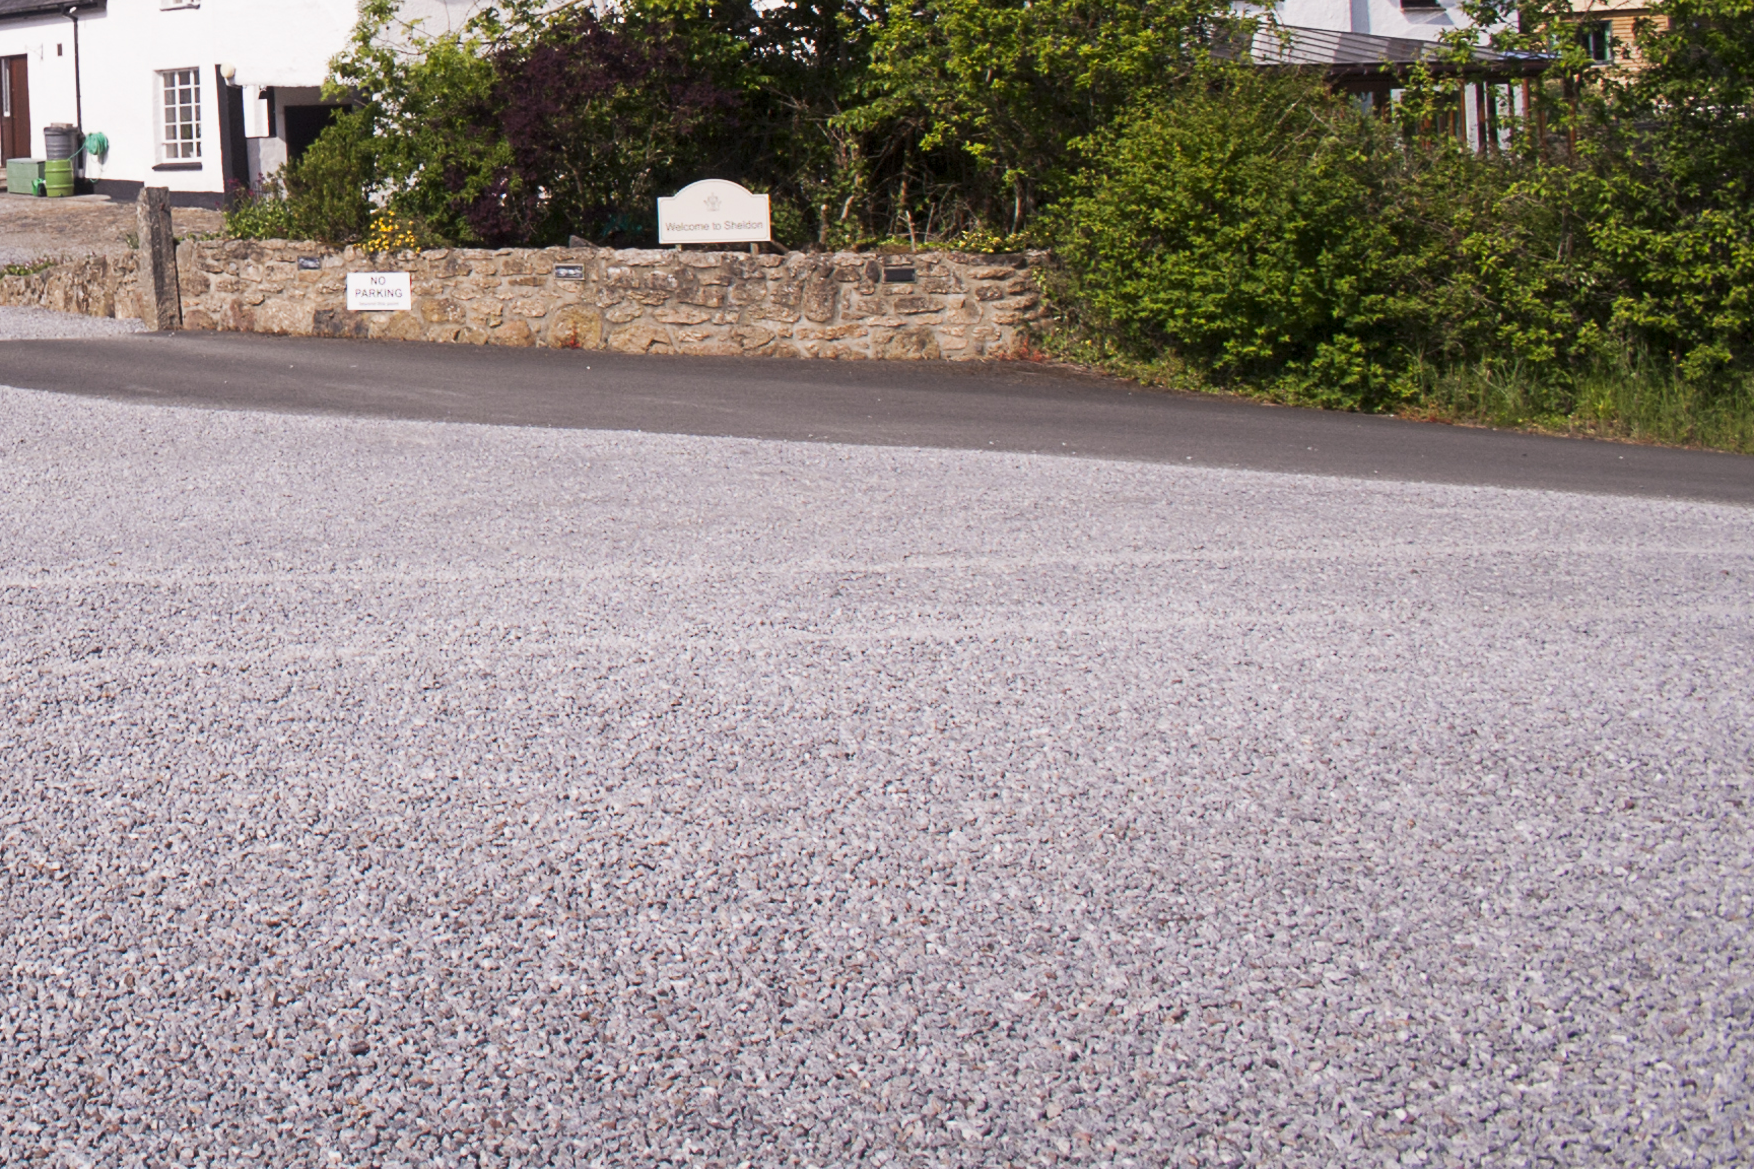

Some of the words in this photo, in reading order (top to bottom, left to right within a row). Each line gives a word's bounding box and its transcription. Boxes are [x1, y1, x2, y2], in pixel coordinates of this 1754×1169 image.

[665, 222, 710, 232] Welcome
[712, 221, 722, 231] to
[724, 220, 764, 230] Sheldon
[370, 276, 386, 285] NO
[355, 288, 403, 298] PARKING
